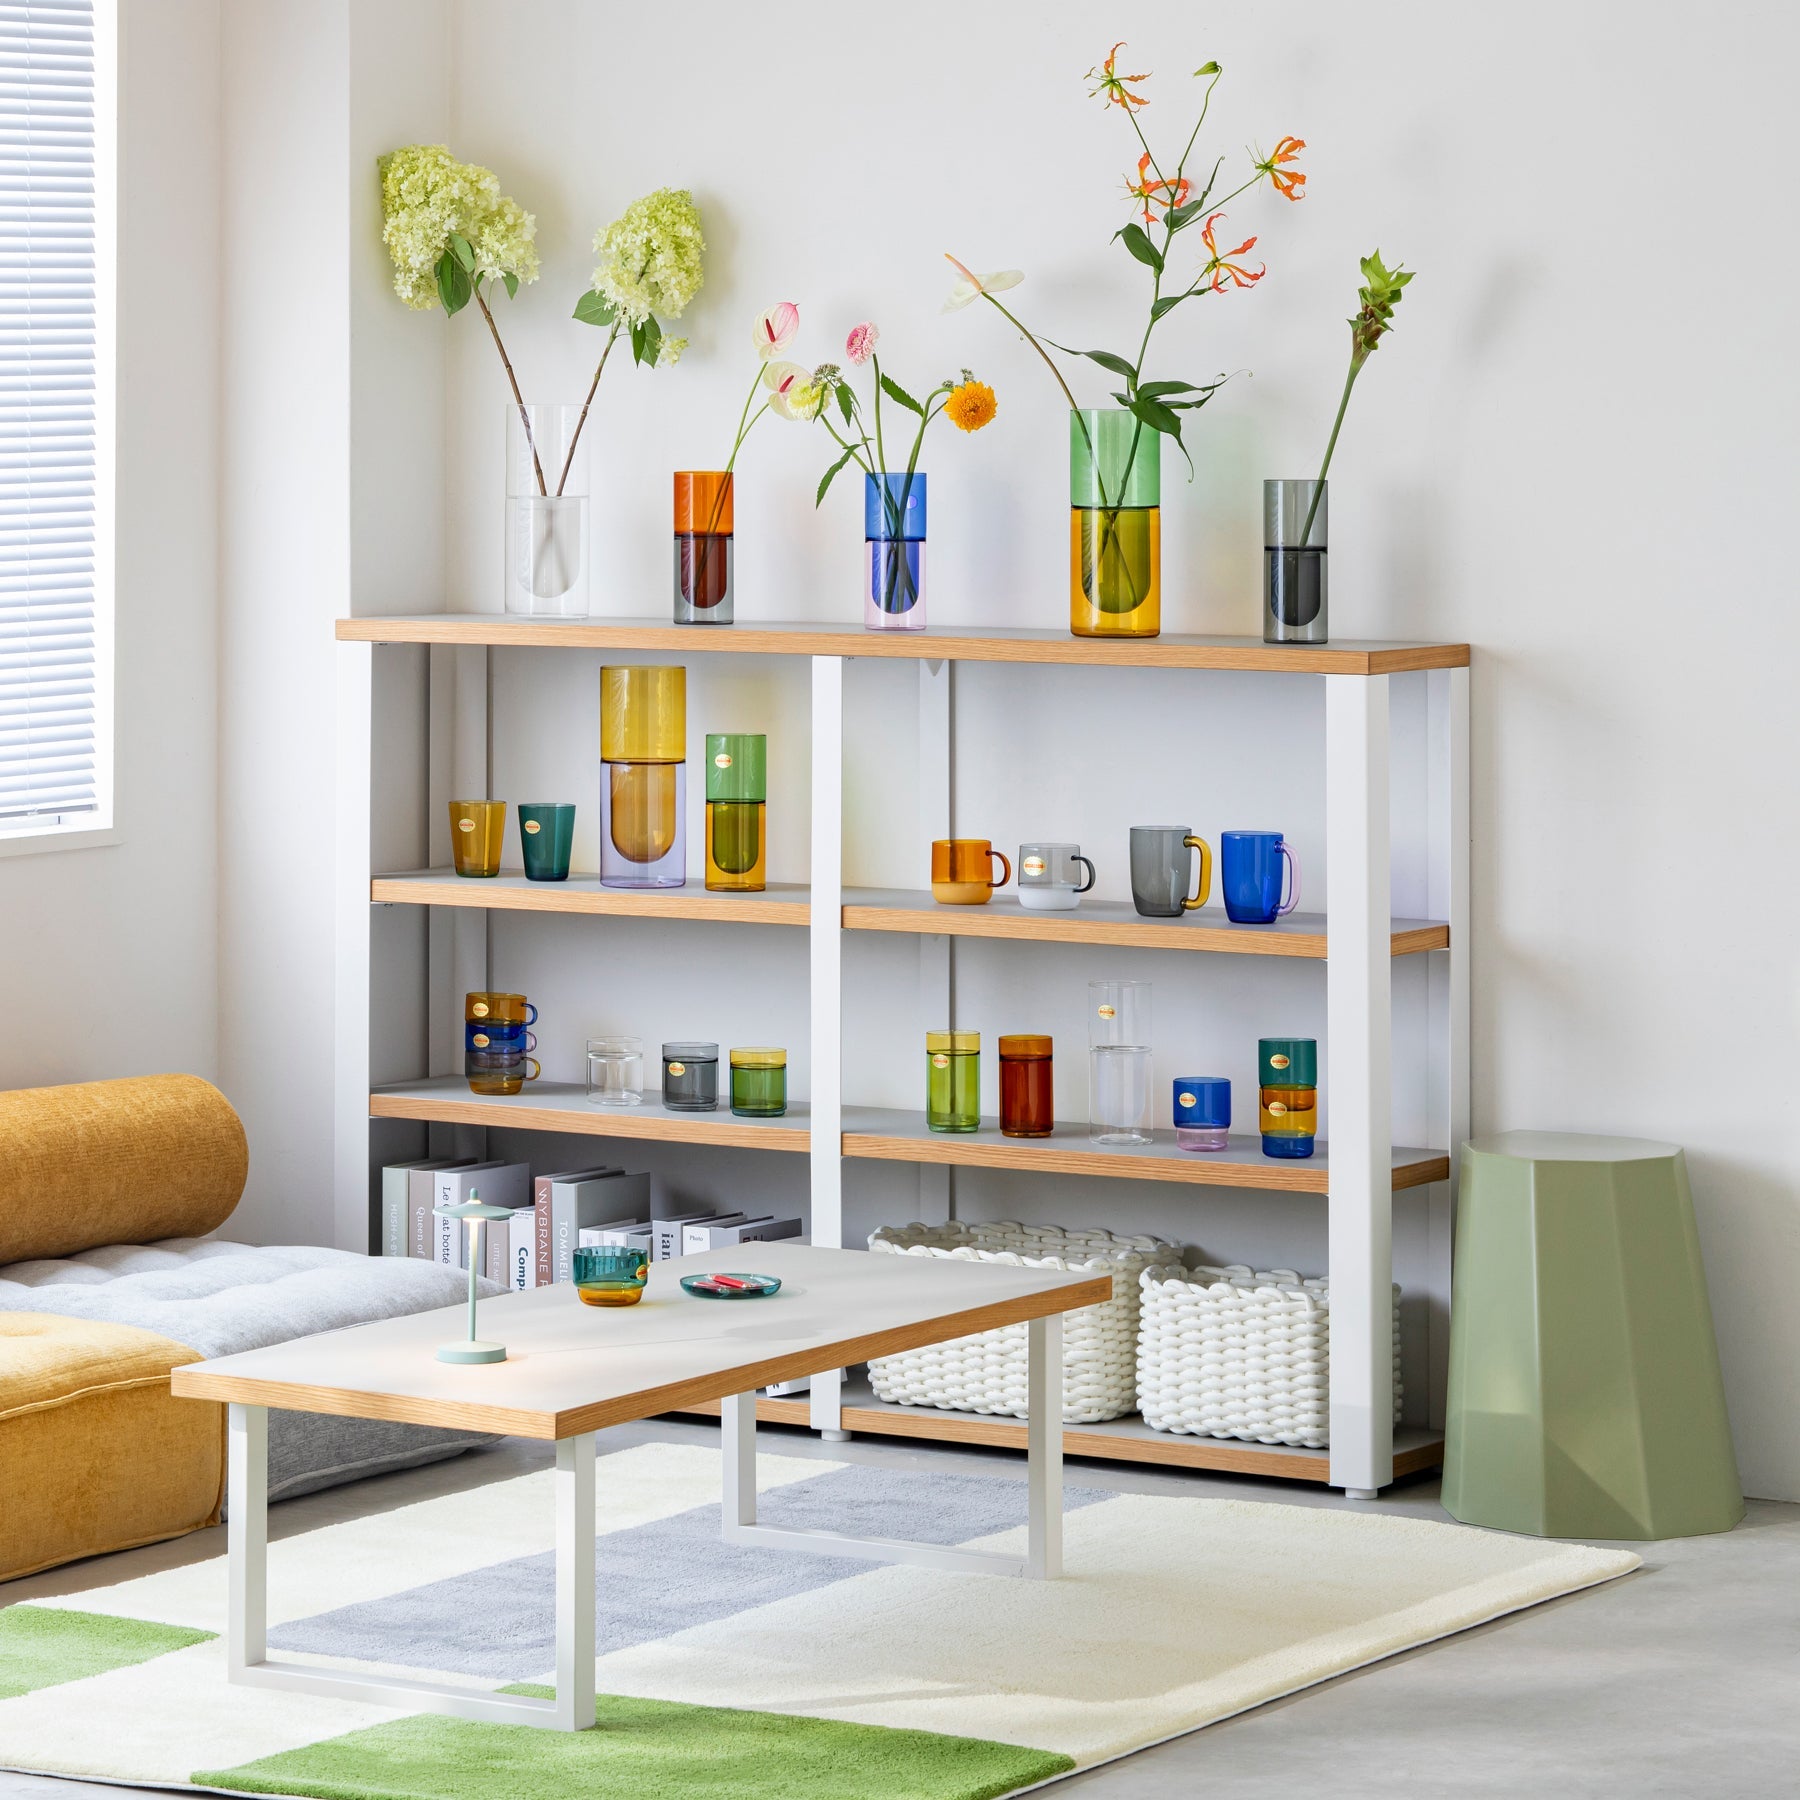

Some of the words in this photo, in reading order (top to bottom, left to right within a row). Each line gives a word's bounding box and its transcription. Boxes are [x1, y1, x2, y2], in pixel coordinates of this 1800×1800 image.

[442, 1187, 450, 1201] Le
[416, 1206, 426, 1241] Queen
[538, 1187, 549, 1273] WYBRANE
[442, 1234, 451, 1264] botté
